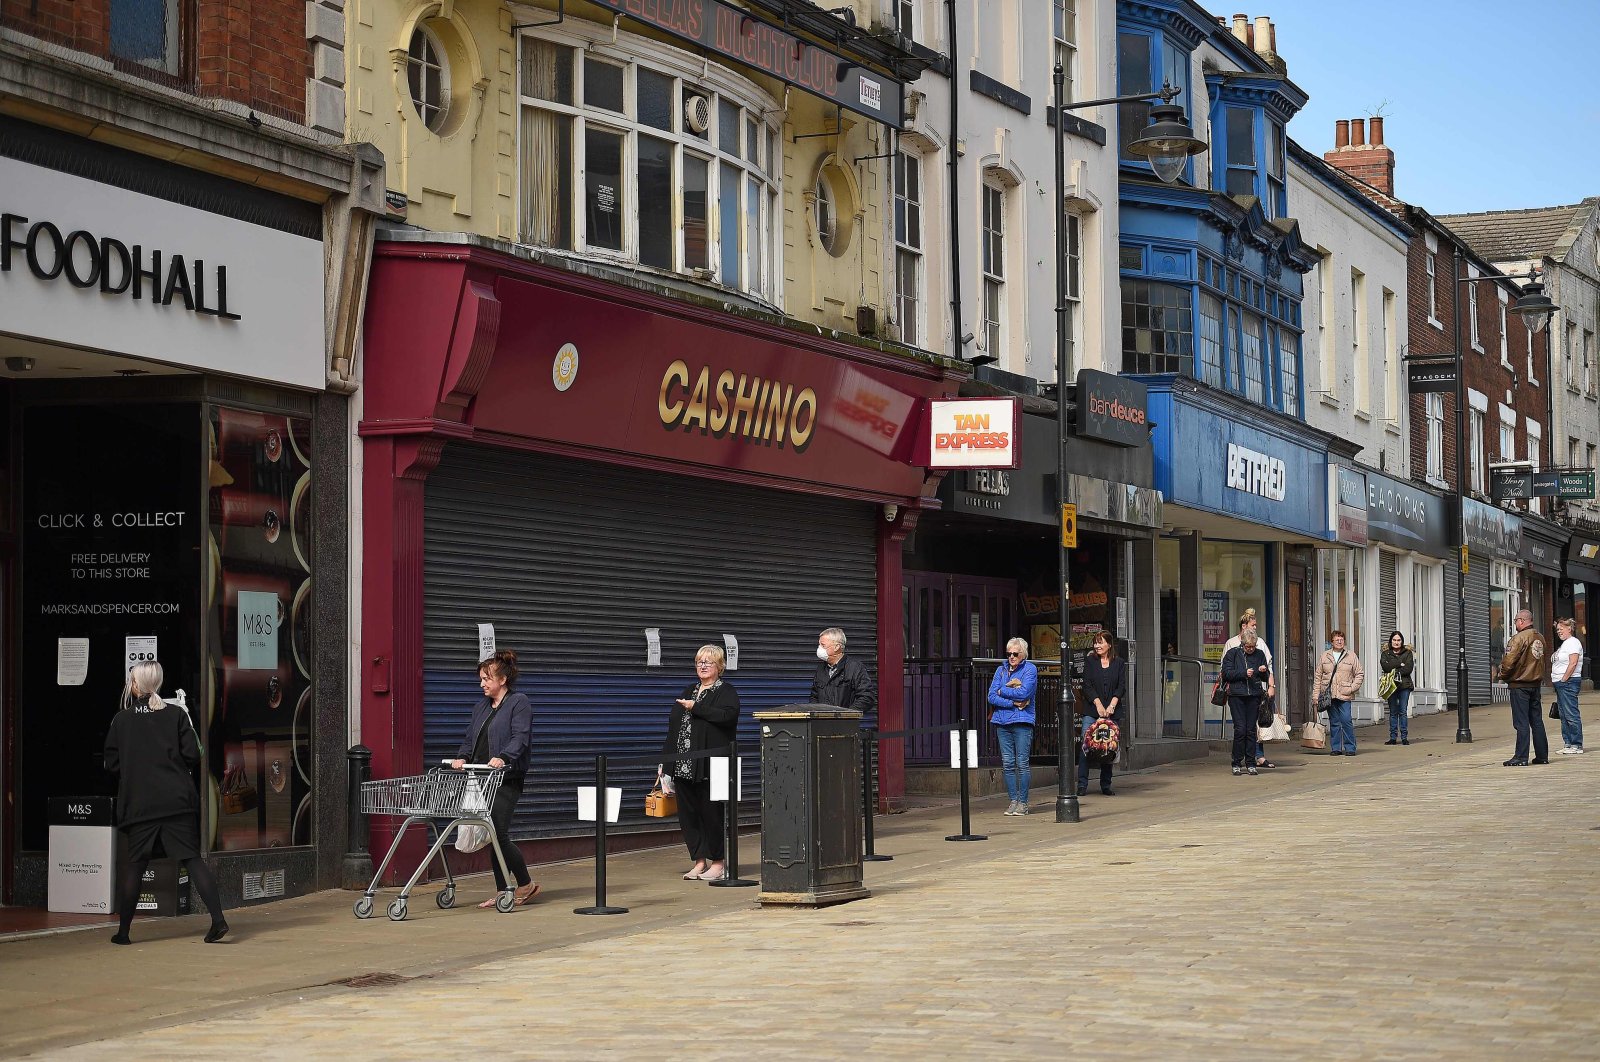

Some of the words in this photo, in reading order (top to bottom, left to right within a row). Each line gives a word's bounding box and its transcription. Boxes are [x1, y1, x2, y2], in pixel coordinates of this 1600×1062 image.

[716, 6, 838, 96] NIGHTCLUB
[1, 213, 241, 320] FOODHALL
[658, 359, 817, 448] CASHINO
[1089, 391, 1145, 425] bardeuce
[954, 414, 990, 431] TAN
[935, 432, 1009, 449] EXPRESS
[1227, 443, 1286, 501] BETFRED
[1369, 483, 1426, 523] EACOCKS
[38, 514, 85, 528] CLICK
[93, 514, 103, 527] &
[112, 512, 185, 527] COLLECT
[71, 554, 97, 563] FREE
[100, 553, 151, 563] DELIVERY
[71, 569, 86, 578] TO
[89, 568, 112, 578] THIS
[115, 568, 150, 578] STORE
[41, 603, 180, 614] MARKSANDSPENCER.COM
[1203, 599, 1224, 610] BEST
[243, 613, 273, 635] M&S
[68, 804, 92, 815] M&S
